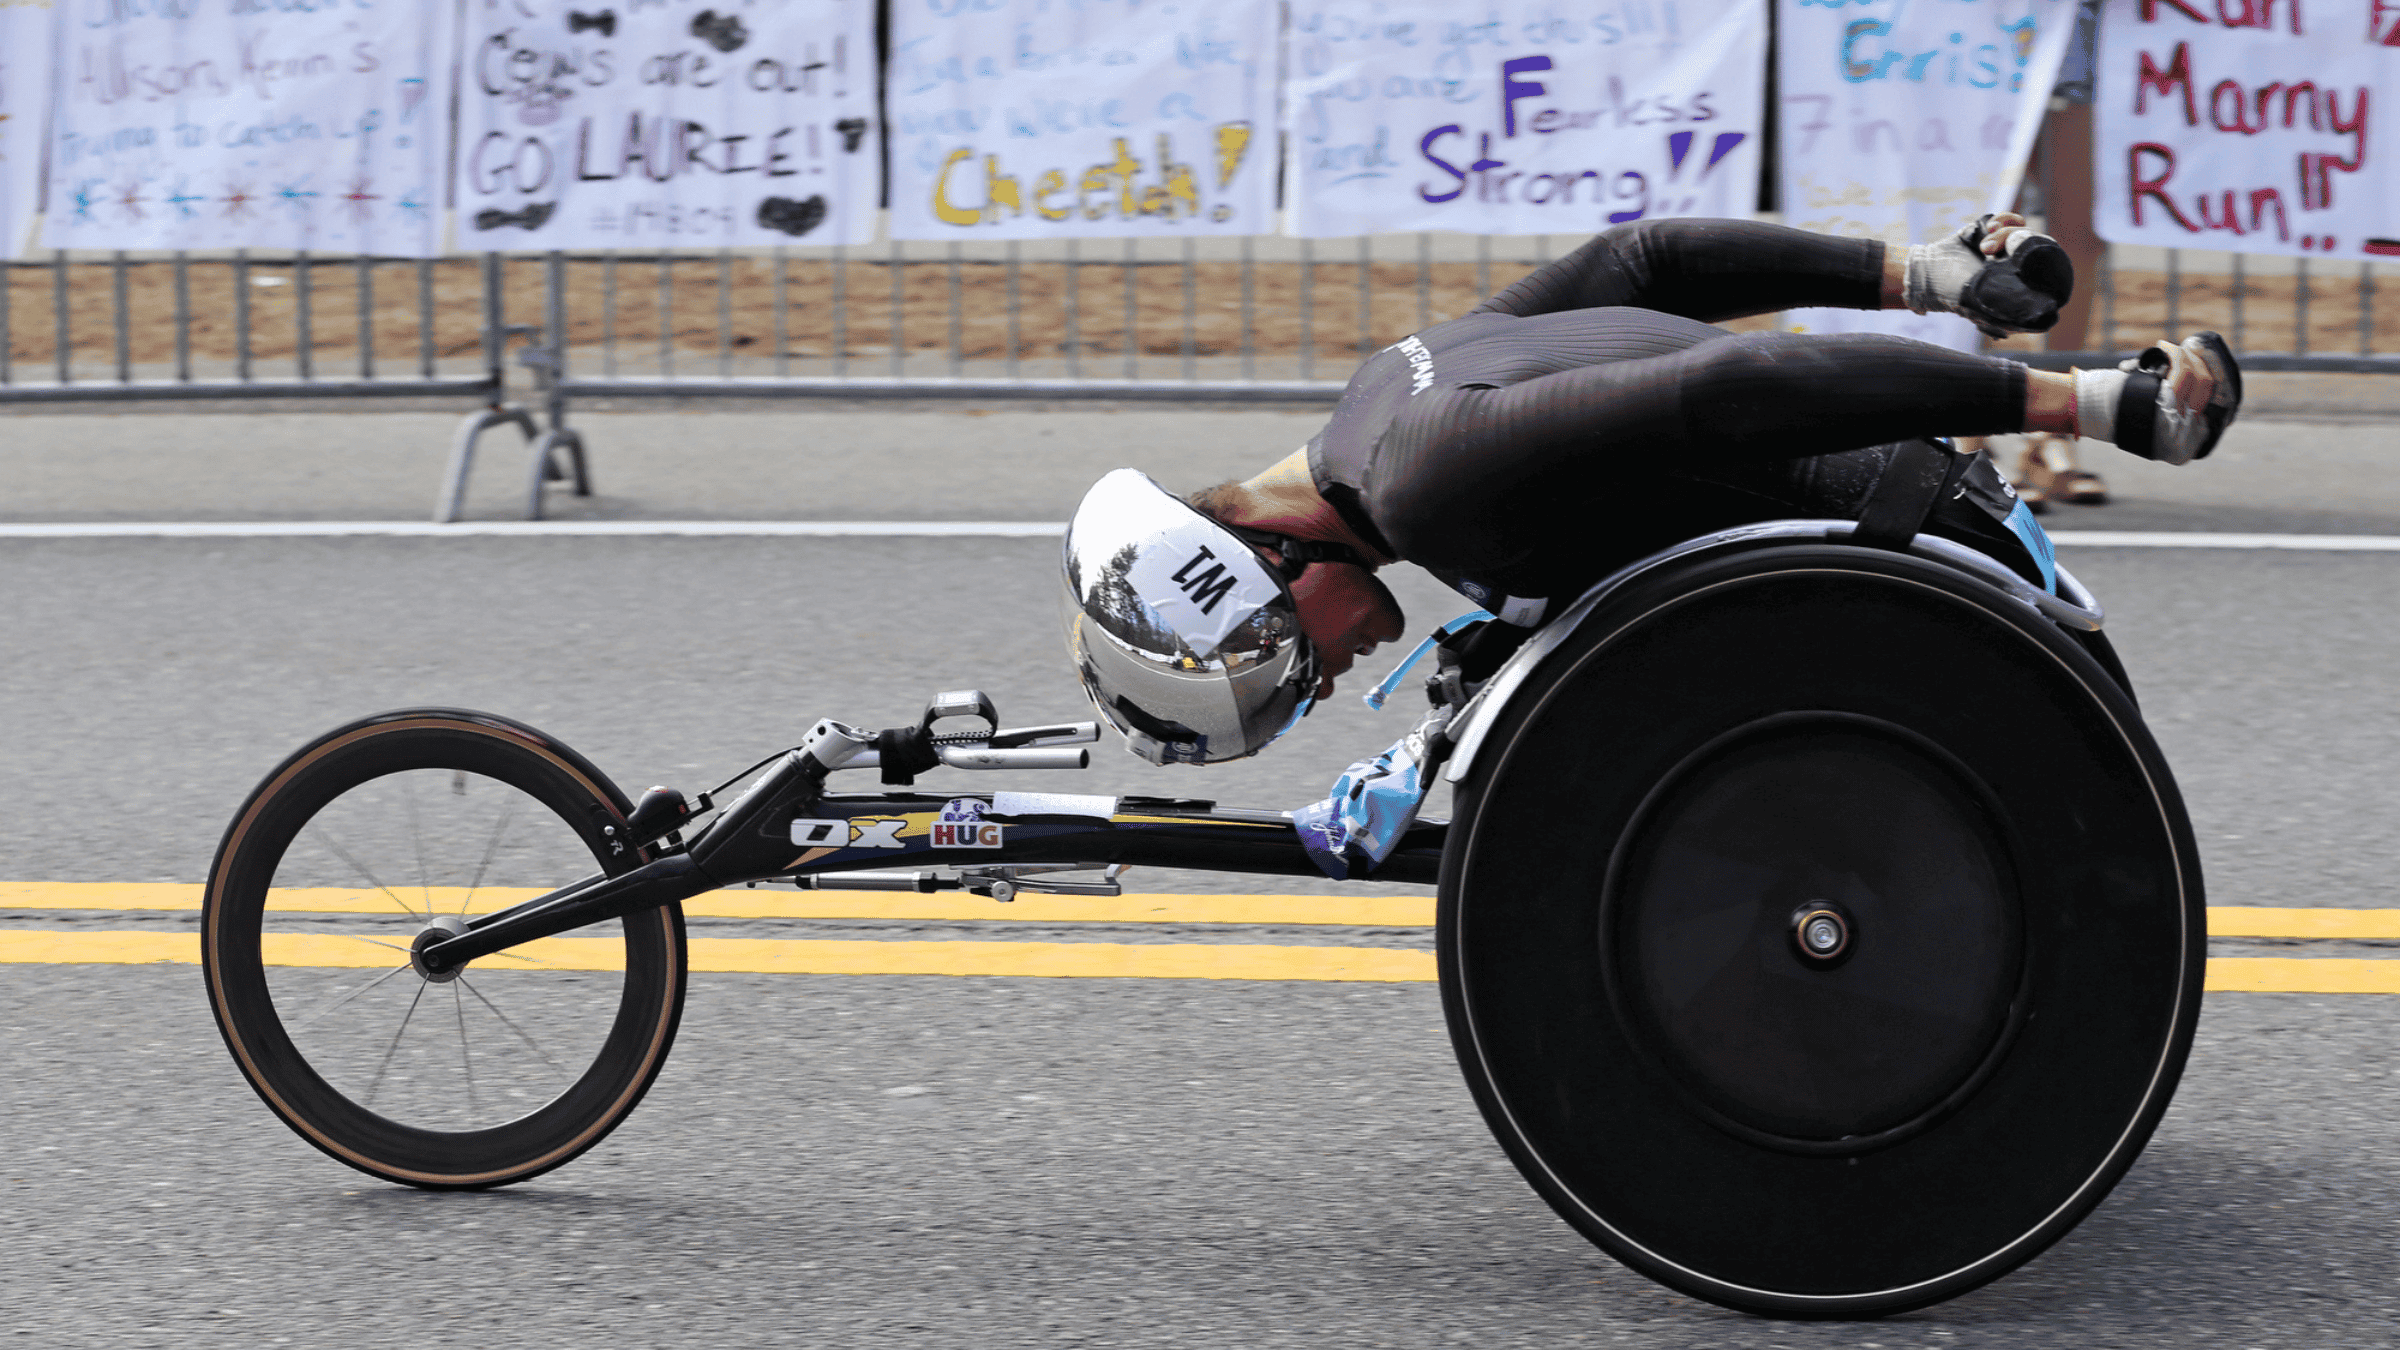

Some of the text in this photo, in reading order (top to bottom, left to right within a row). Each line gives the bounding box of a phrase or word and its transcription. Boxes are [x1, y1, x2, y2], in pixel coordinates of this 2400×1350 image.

[2138, 0, 2303, 34] un
[1502, 54, 1717, 138] Fearless
[1783, 92, 1834, 154] 7
[468, 130, 554, 195] GO
[931, 120, 1256, 230] Cheetah!
[1416, 124, 1748, 226] Strong!!
[1170, 544, 1239, 616] W1
[790, 818, 907, 849] OX
[933, 824, 1000, 847] HUG
